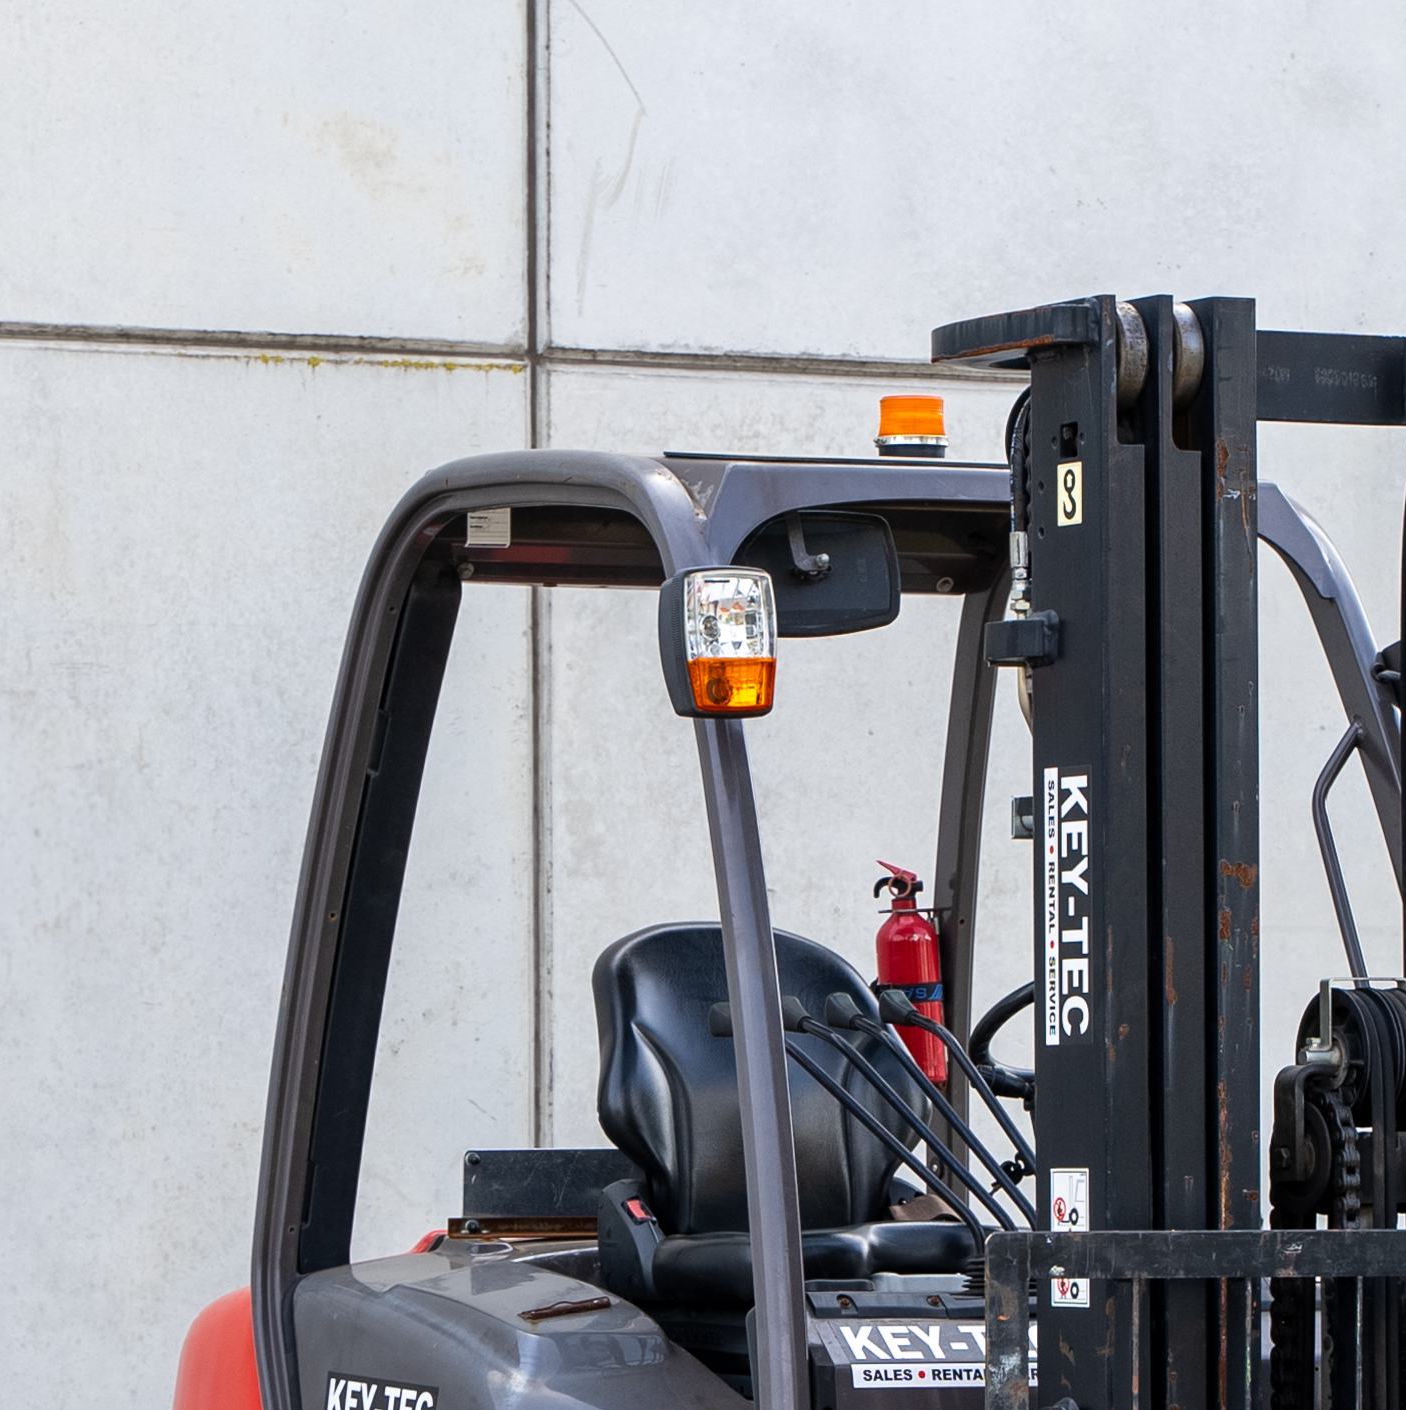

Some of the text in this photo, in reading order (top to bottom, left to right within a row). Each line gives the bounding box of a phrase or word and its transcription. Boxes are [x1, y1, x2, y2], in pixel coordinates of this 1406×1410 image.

[1047, 779, 1055, 839] SALES
[1060, 774, 1090, 1037] KEY-TEC
[1048, 956, 1056, 1037] SERVICE
[862, 1369, 985, 1382] SALES RENTA
